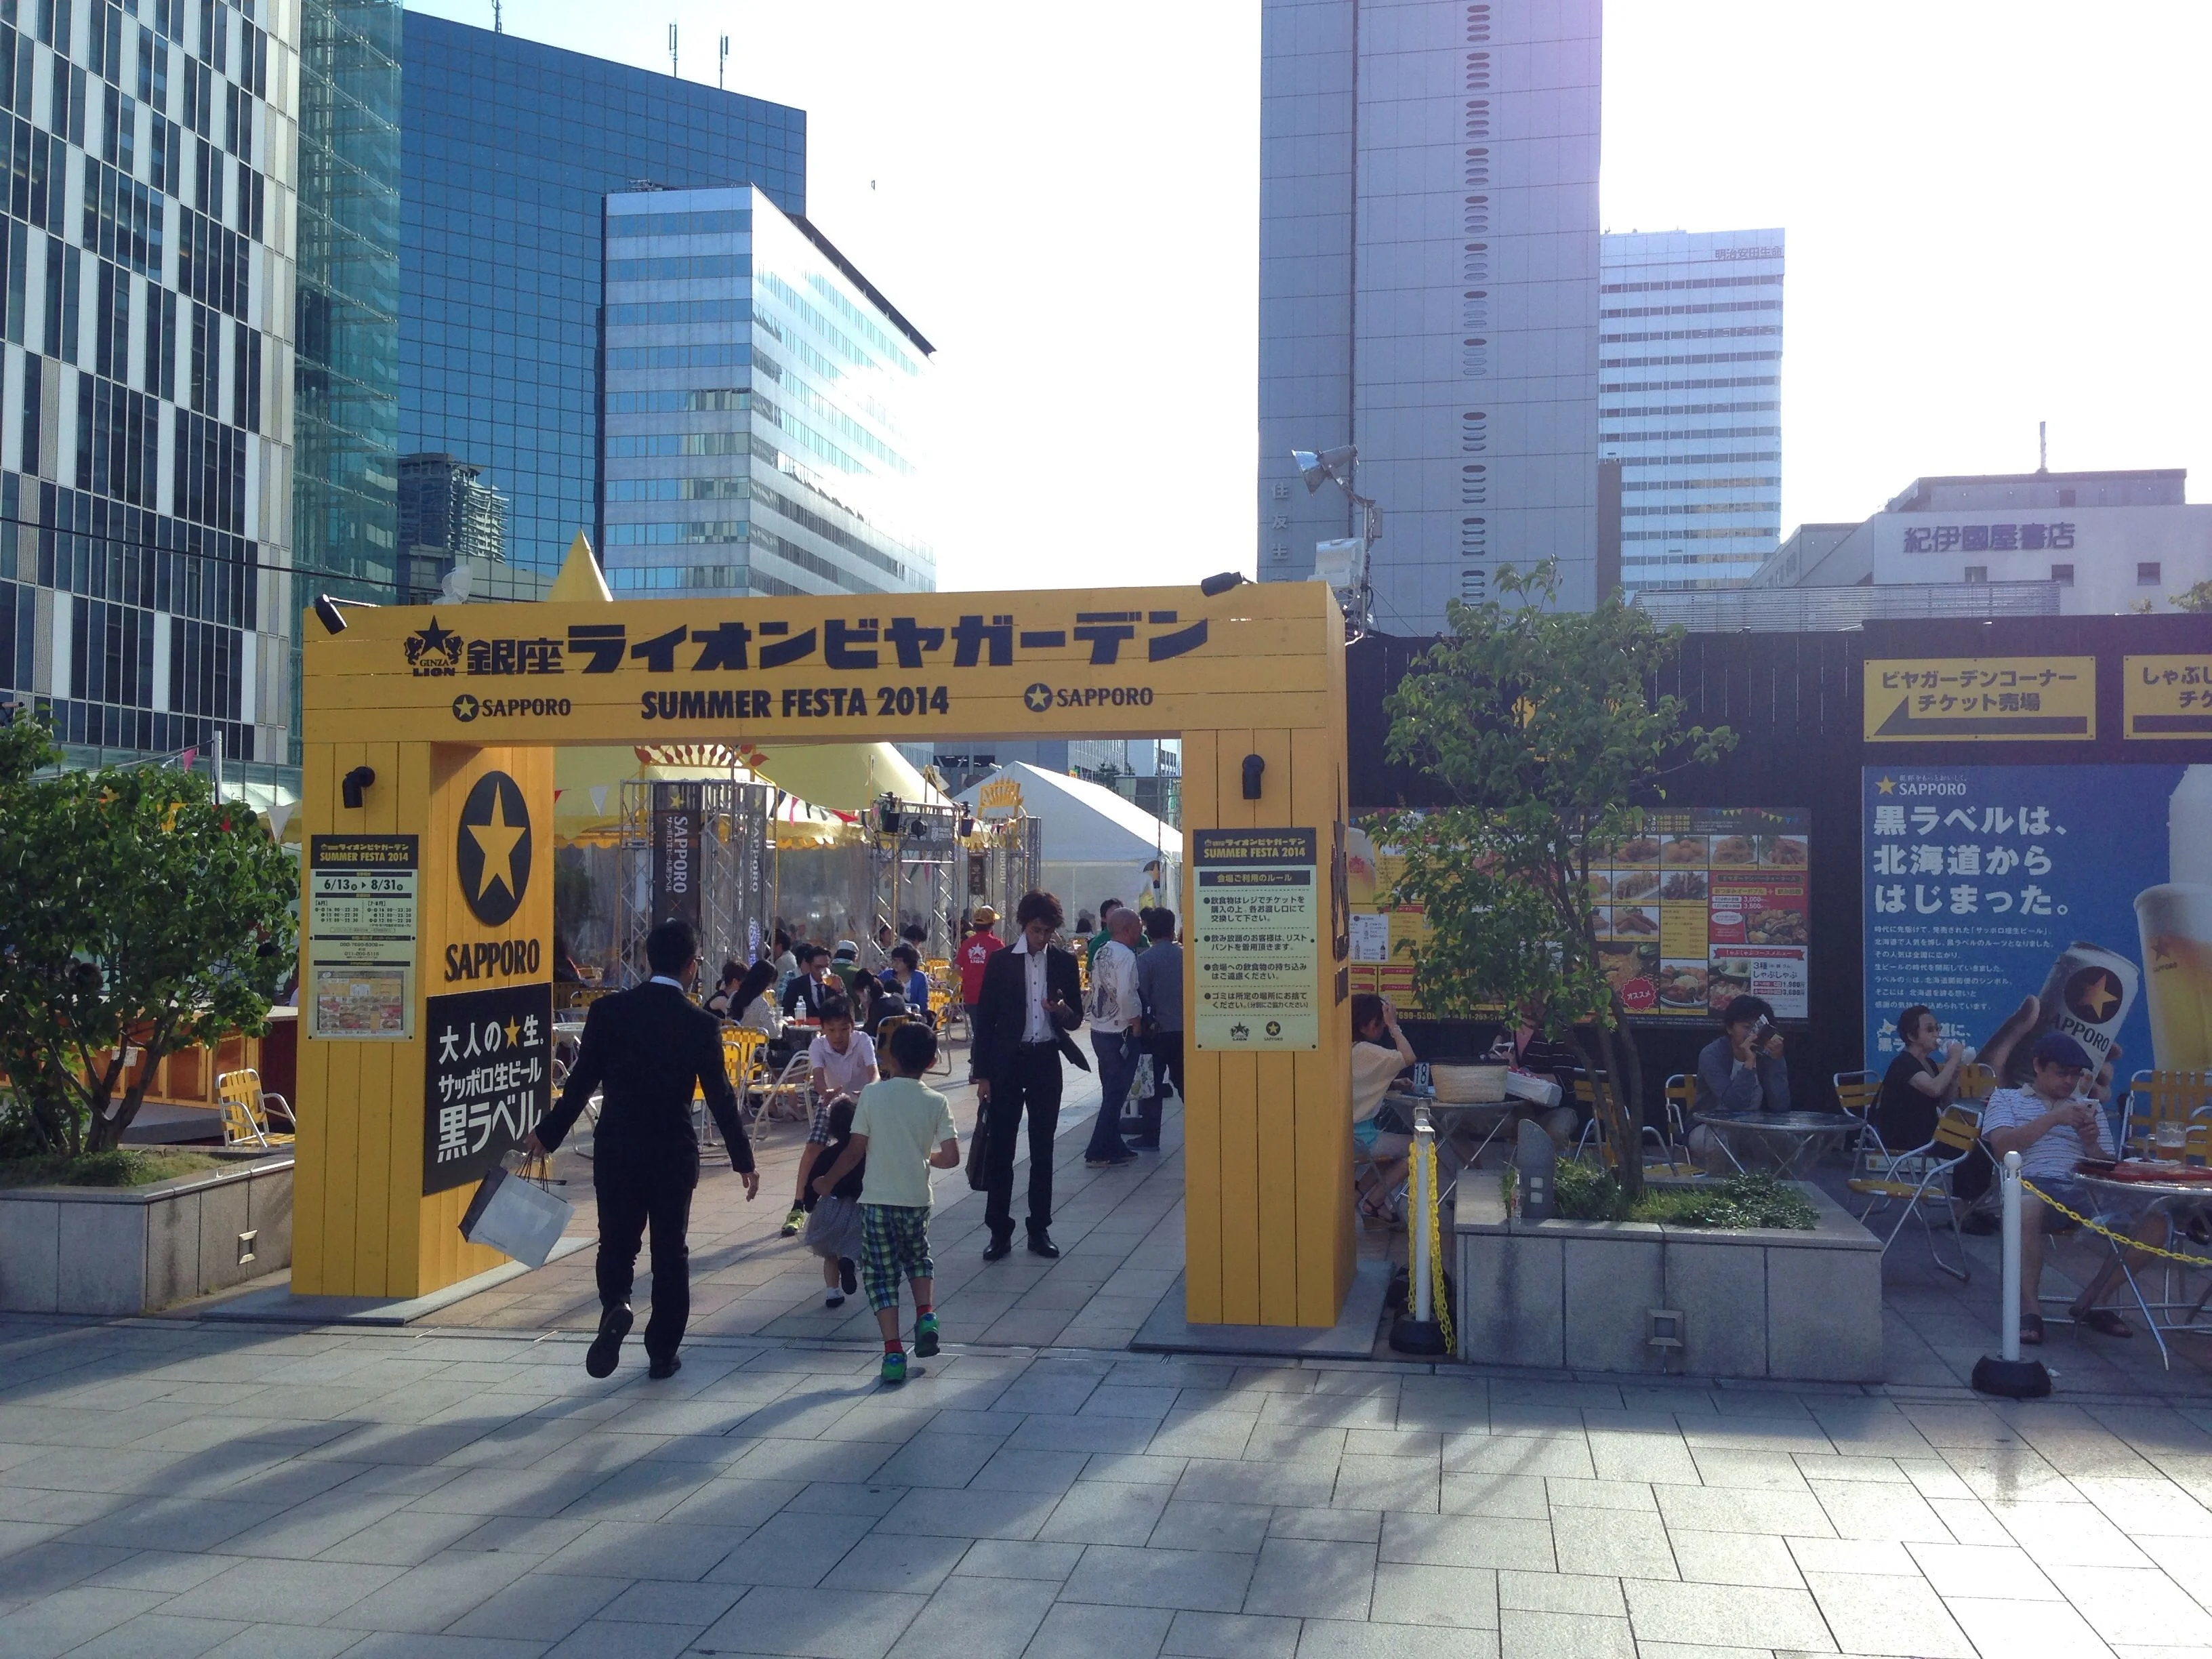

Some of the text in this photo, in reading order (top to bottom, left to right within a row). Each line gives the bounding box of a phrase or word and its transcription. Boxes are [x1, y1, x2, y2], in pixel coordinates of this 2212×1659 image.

[1715, 247, 1782, 261] 明治安田生命
[1272, 482, 1290, 582] 住友生
[1904, 523, 2075, 553] 紀伊國屋書店
[467, 611, 1208, 675] 銀座ライオンビヤガーデン
[413, 668, 455, 676] LION
[419, 659, 449, 668] GINZA
[1882, 669, 2077, 690] ビヤガーデンコーナー
[641, 686, 949, 720] SUMMER FESTA 2014
[1057, 687, 1153, 707] SAPPORO
[1918, 693, 2041, 713] チケット売場
[482, 698, 571, 717] SAPPORO
[1899, 783, 1967, 796] SAPPORO
[1873, 805, 2067, 836] 黒ラベルは、
[320, 853, 409, 861] SUMMER FESTA 2014
[674, 817, 688, 893] SAPPORO
[1204, 847, 1305, 858] SUMMER FESTA 2014
[1873, 844, 2052, 876] 北海道から
[1217, 874, 1292, 883] 会場ご利用のルール
[1875, 884, 2068, 915] はじまった。
[1211, 914, 1271, 922] 交換して下さい。
[444, 939, 540, 983] SAPPORO
[1626, 991, 1652, 1001] オススメ
[2051, 1014, 2110, 1052] APPORO
[438, 1057, 542, 1103] サッポロ生ビール
[1416, 1064, 1427, 1084] 18
[437, 1090, 541, 1164] 黒ラベル
